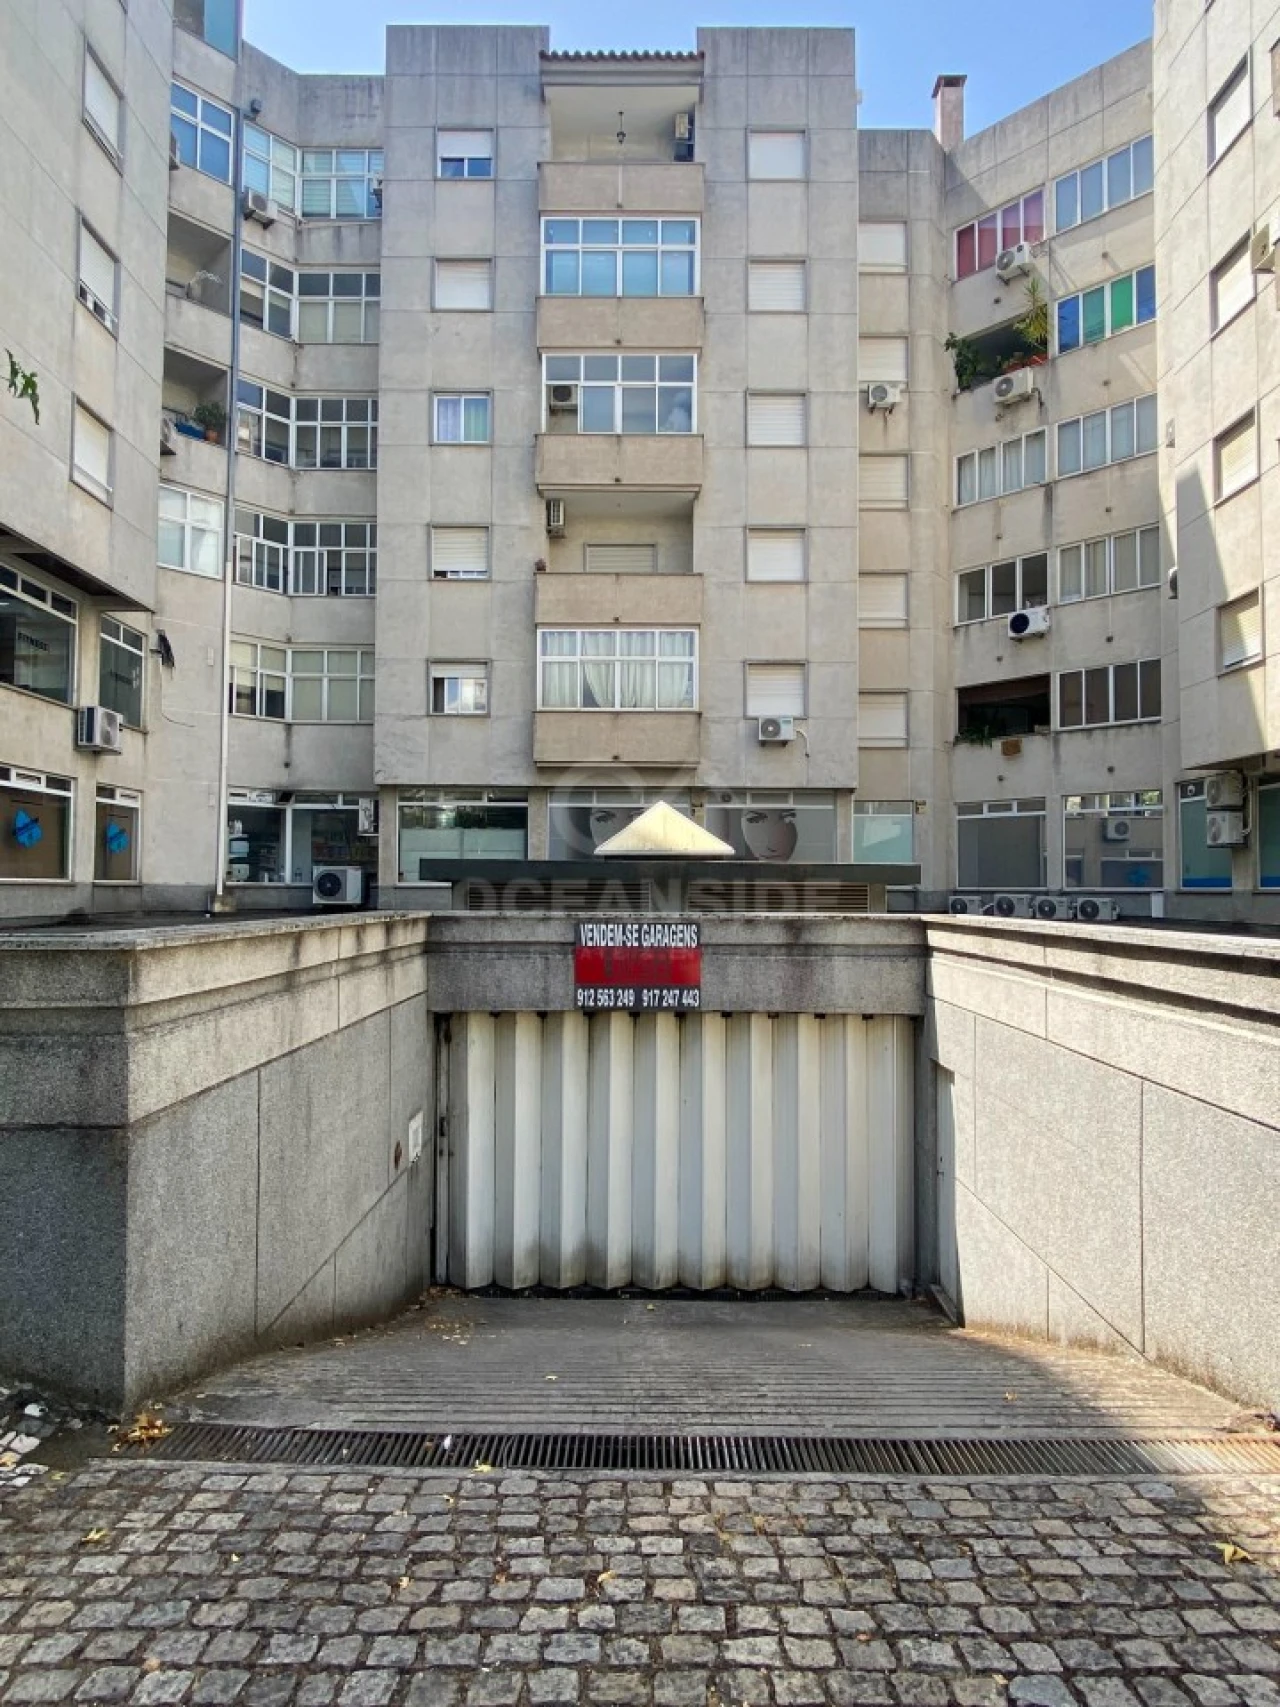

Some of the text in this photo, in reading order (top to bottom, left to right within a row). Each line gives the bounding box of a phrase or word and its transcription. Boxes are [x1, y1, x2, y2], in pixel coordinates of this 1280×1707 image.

[580, 924, 698, 948] VENDEM-SE GARAGENS
[577, 988, 595, 1007] 912
[617, 988, 636, 1007] 249
[642, 988, 660, 1007] 917
[662, 988, 680, 1007] 247
[682, 988, 700, 1007] 443
